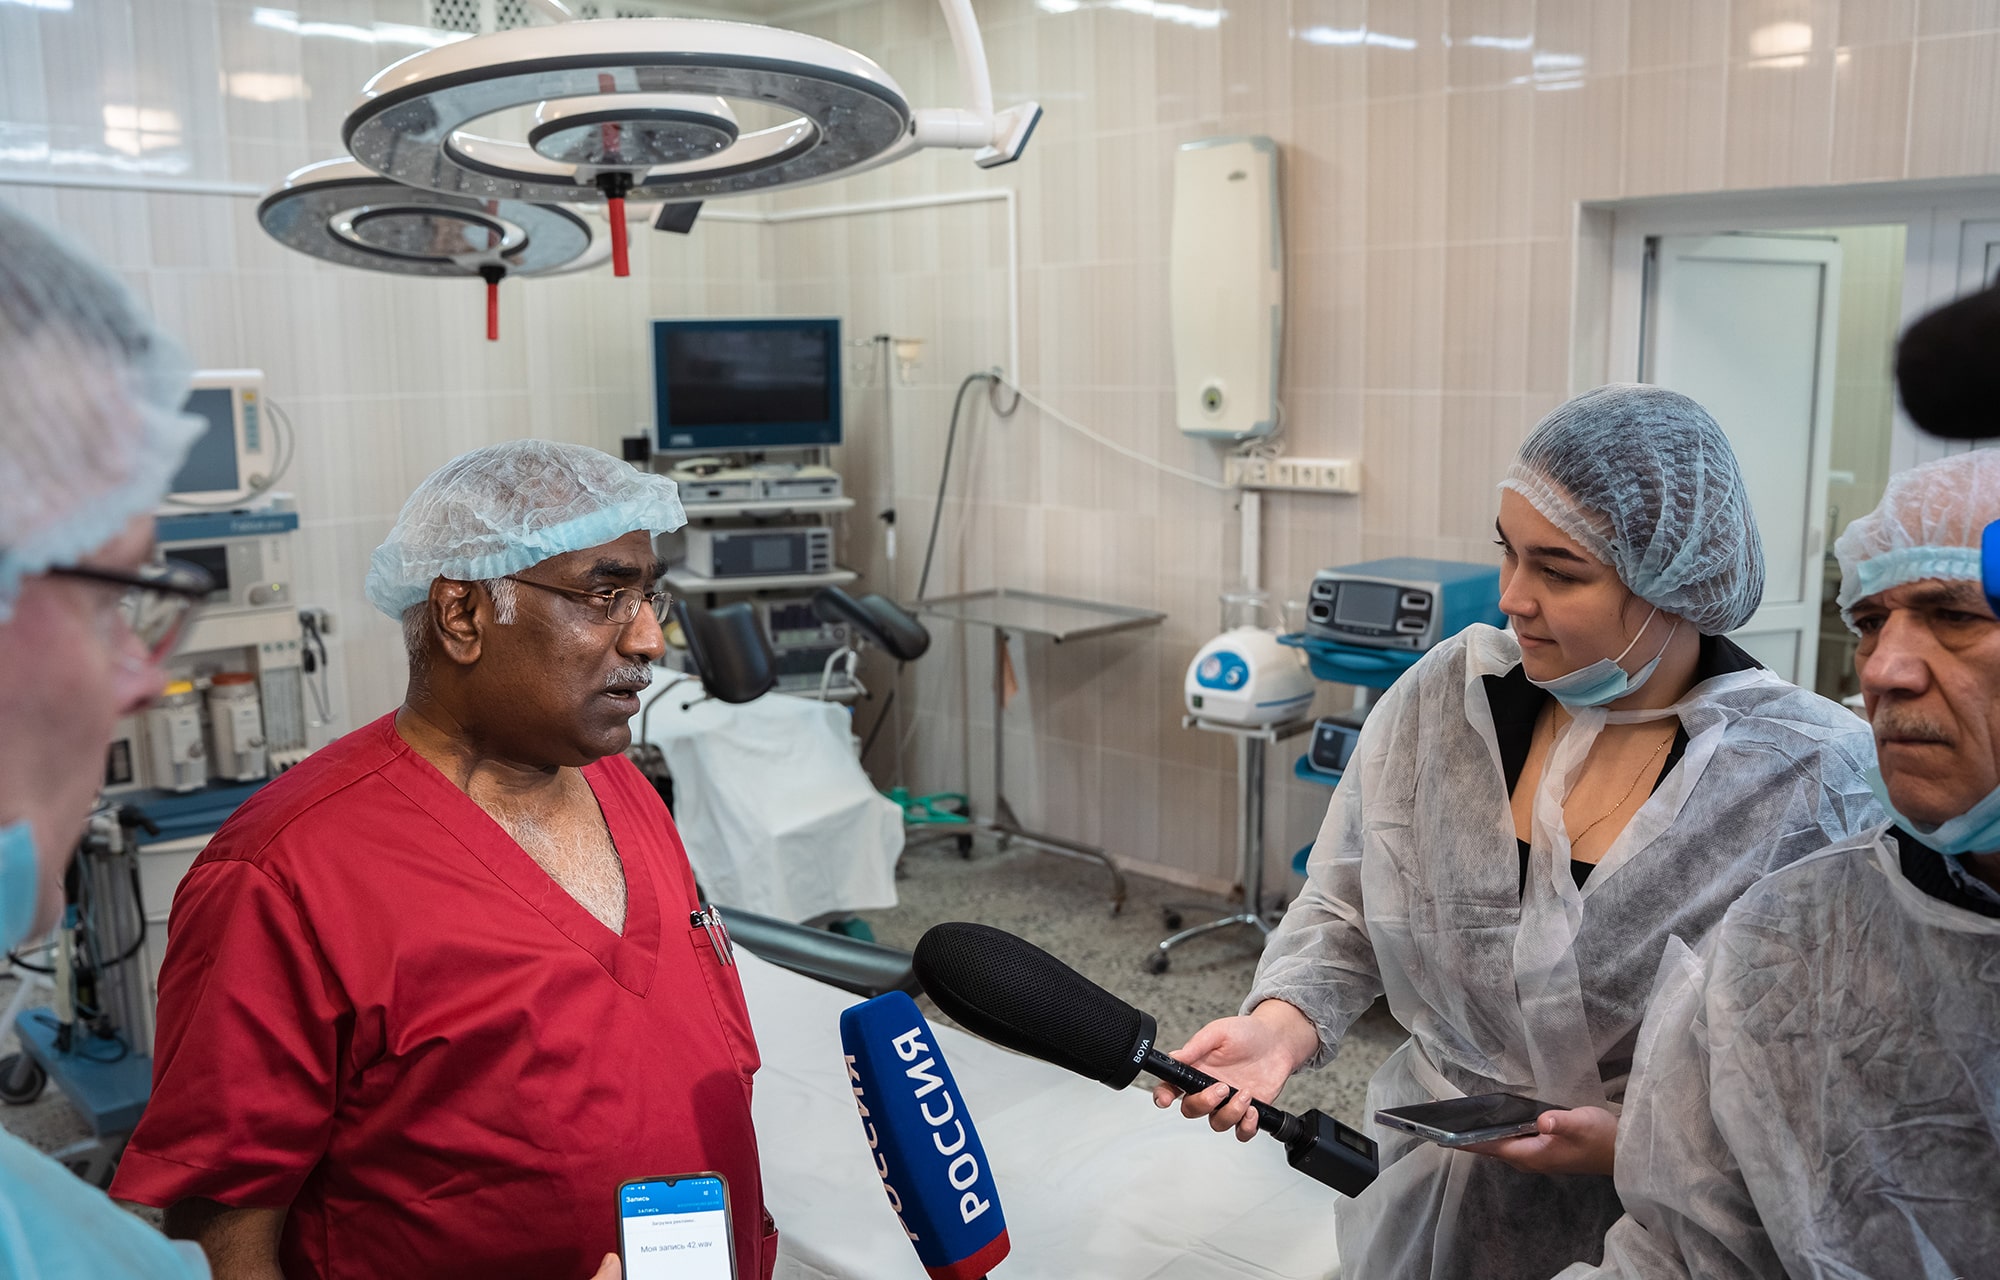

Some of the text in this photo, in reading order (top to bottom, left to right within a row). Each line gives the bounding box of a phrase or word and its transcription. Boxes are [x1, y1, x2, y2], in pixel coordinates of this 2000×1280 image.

[1132, 1039, 1151, 1064] BOYA
[892, 1026, 991, 1225] РОССИЯ
[640, 1245, 657, 1253] Моя
[659, 1243, 686, 1252] запись
